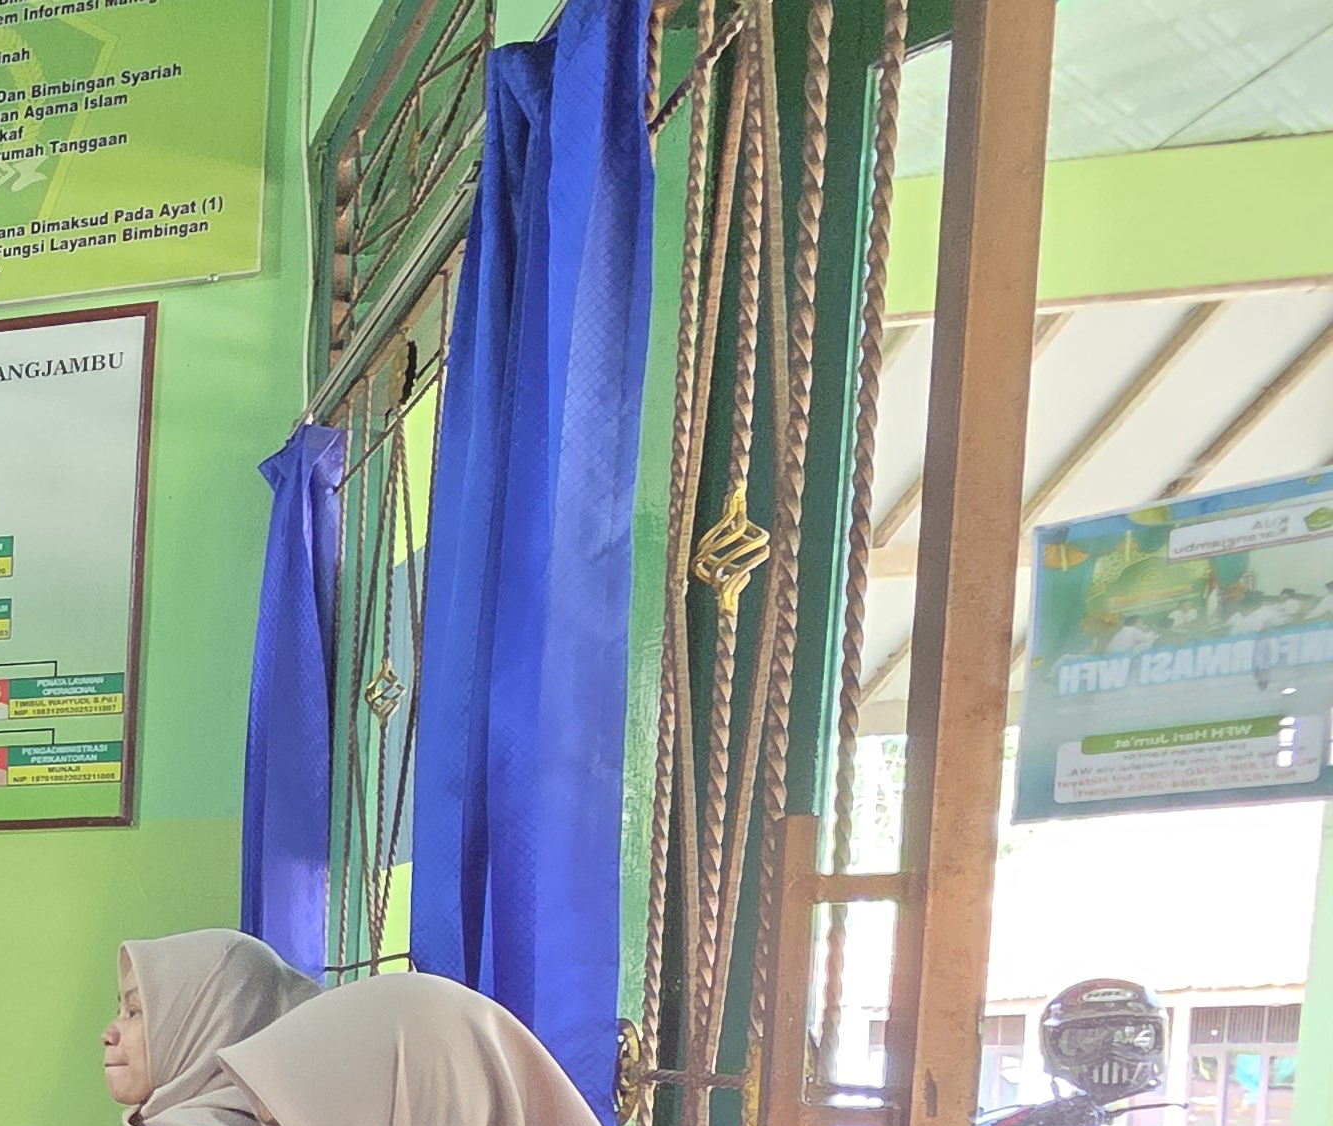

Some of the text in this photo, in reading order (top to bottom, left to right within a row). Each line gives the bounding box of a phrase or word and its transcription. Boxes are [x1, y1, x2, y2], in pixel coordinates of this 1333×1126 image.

[31, 76, 115, 98] Bimbingan
[121, 63, 181, 87] Syariah
[23, 101, 78, 121] Agama
[84, 93, 127, 110] Islam
[31, 211, 108, 234] Dimaksud
[114, 206, 153, 223] Pada
[159, 200, 196, 220] Ayat
[202, 196, 222, 214] (1)
[50, 233, 116, 252] Layanan
[122, 221, 208, 242] Bimbingan
